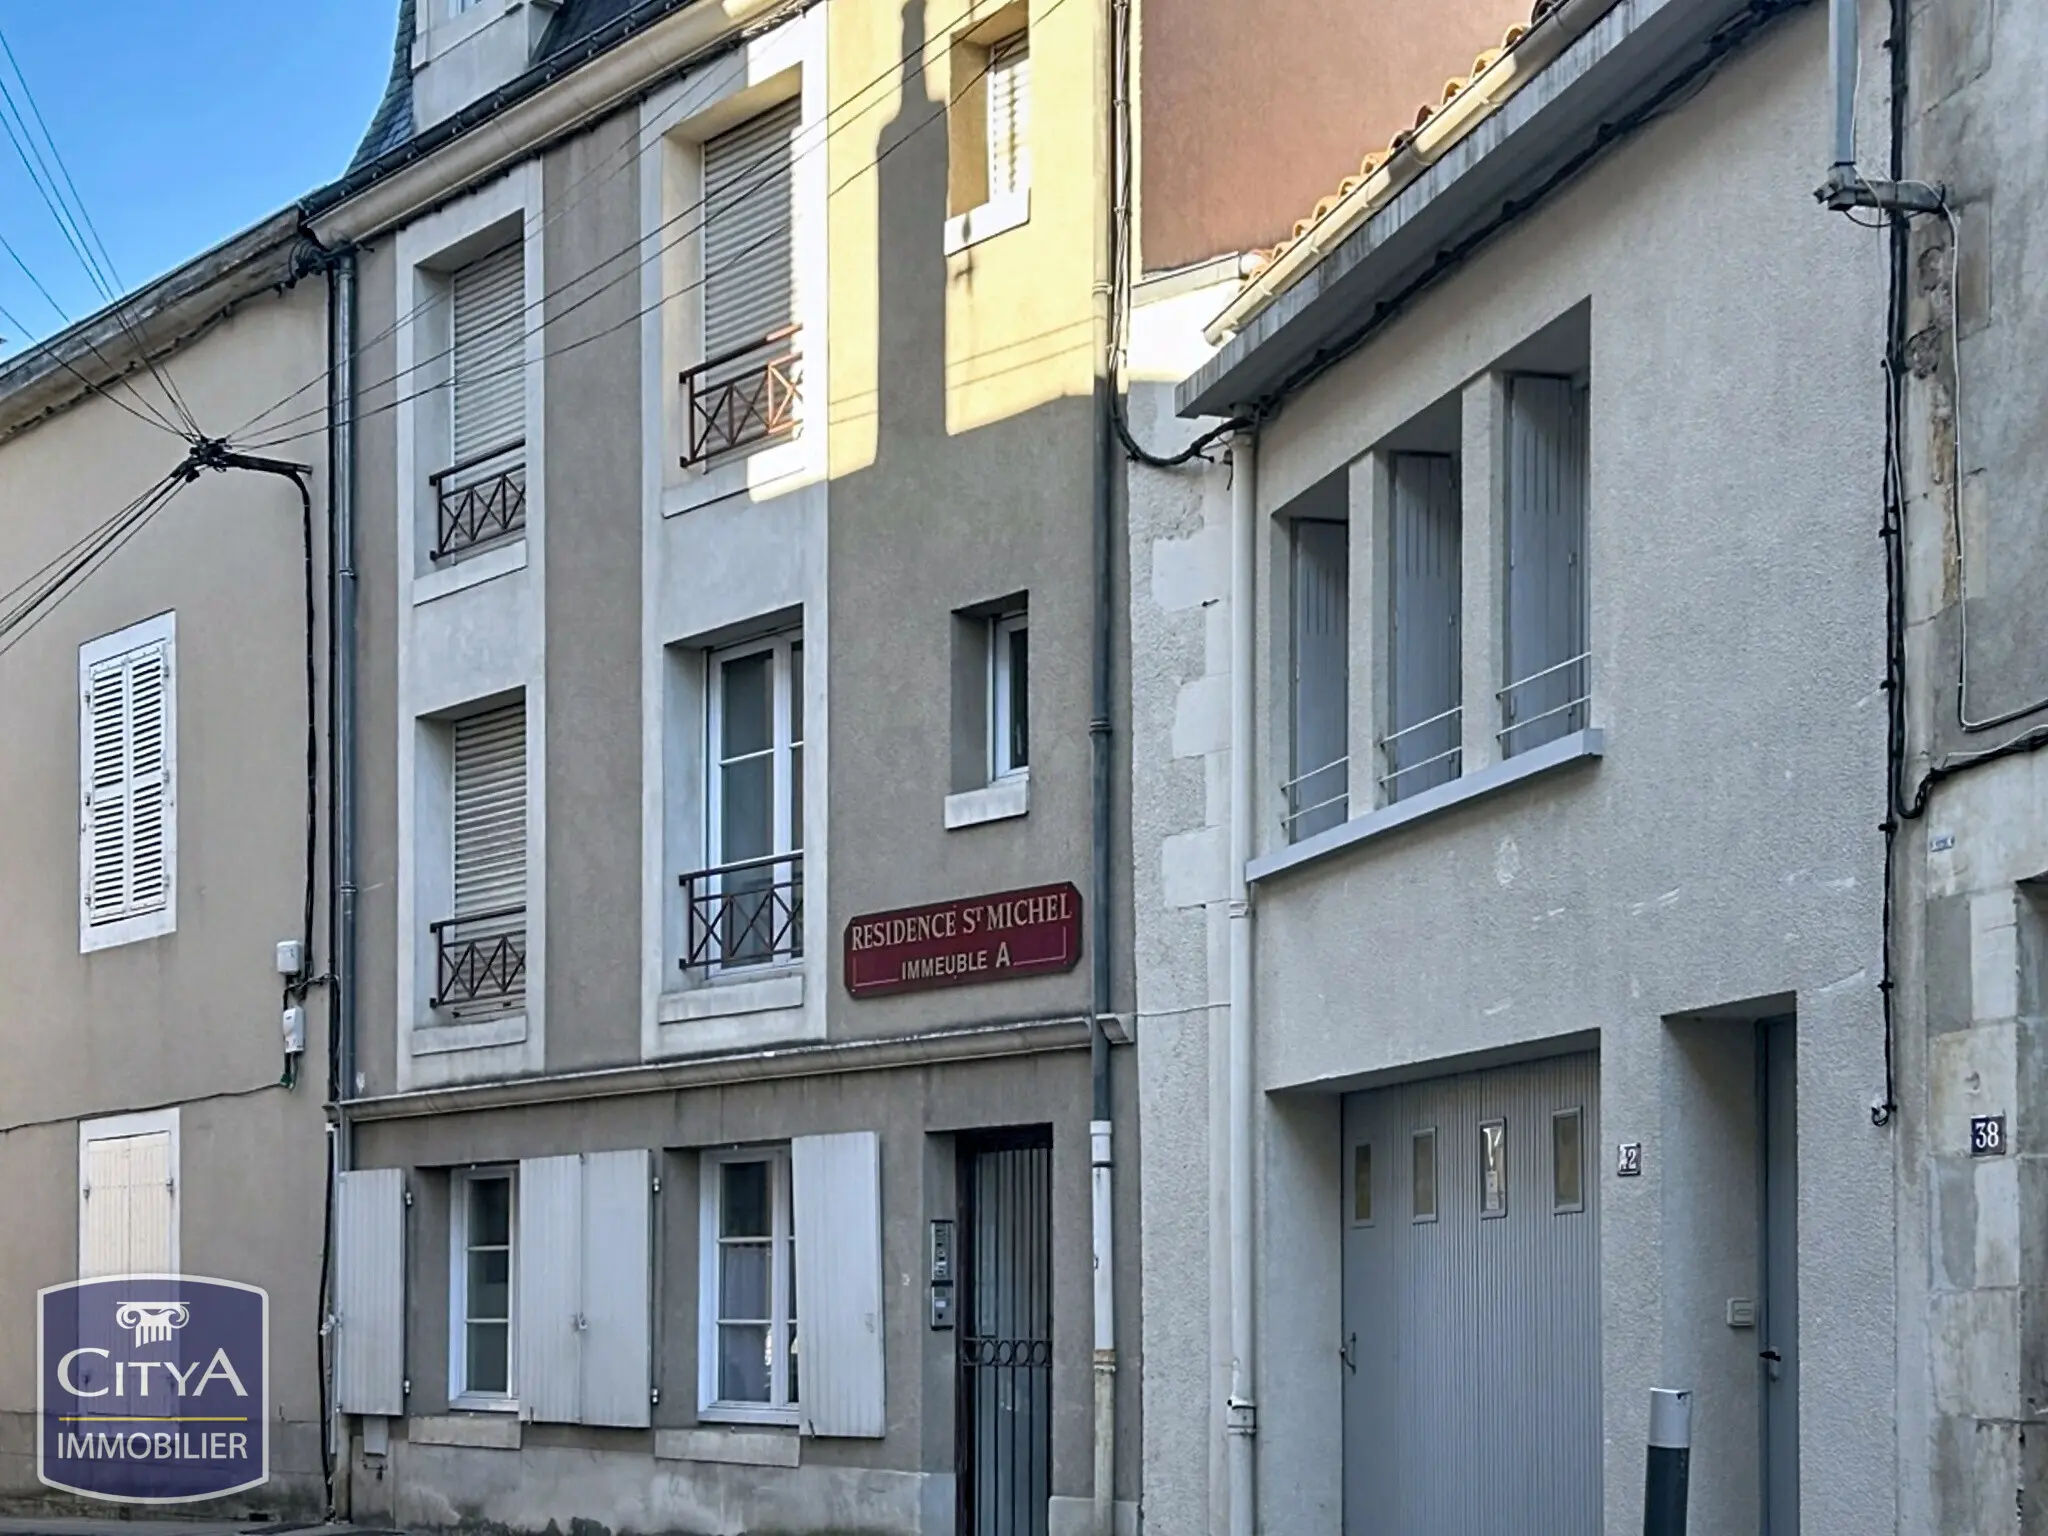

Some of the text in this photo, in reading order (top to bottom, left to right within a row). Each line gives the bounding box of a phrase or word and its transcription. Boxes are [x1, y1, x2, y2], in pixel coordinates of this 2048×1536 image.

[852, 910, 956, 951] RESIDENCE
[987, 893, 1072, 932] MICHEL
[901, 941, 1010, 981] IMMEUBLE A
[1975, 1121, 1999, 1148] 38
